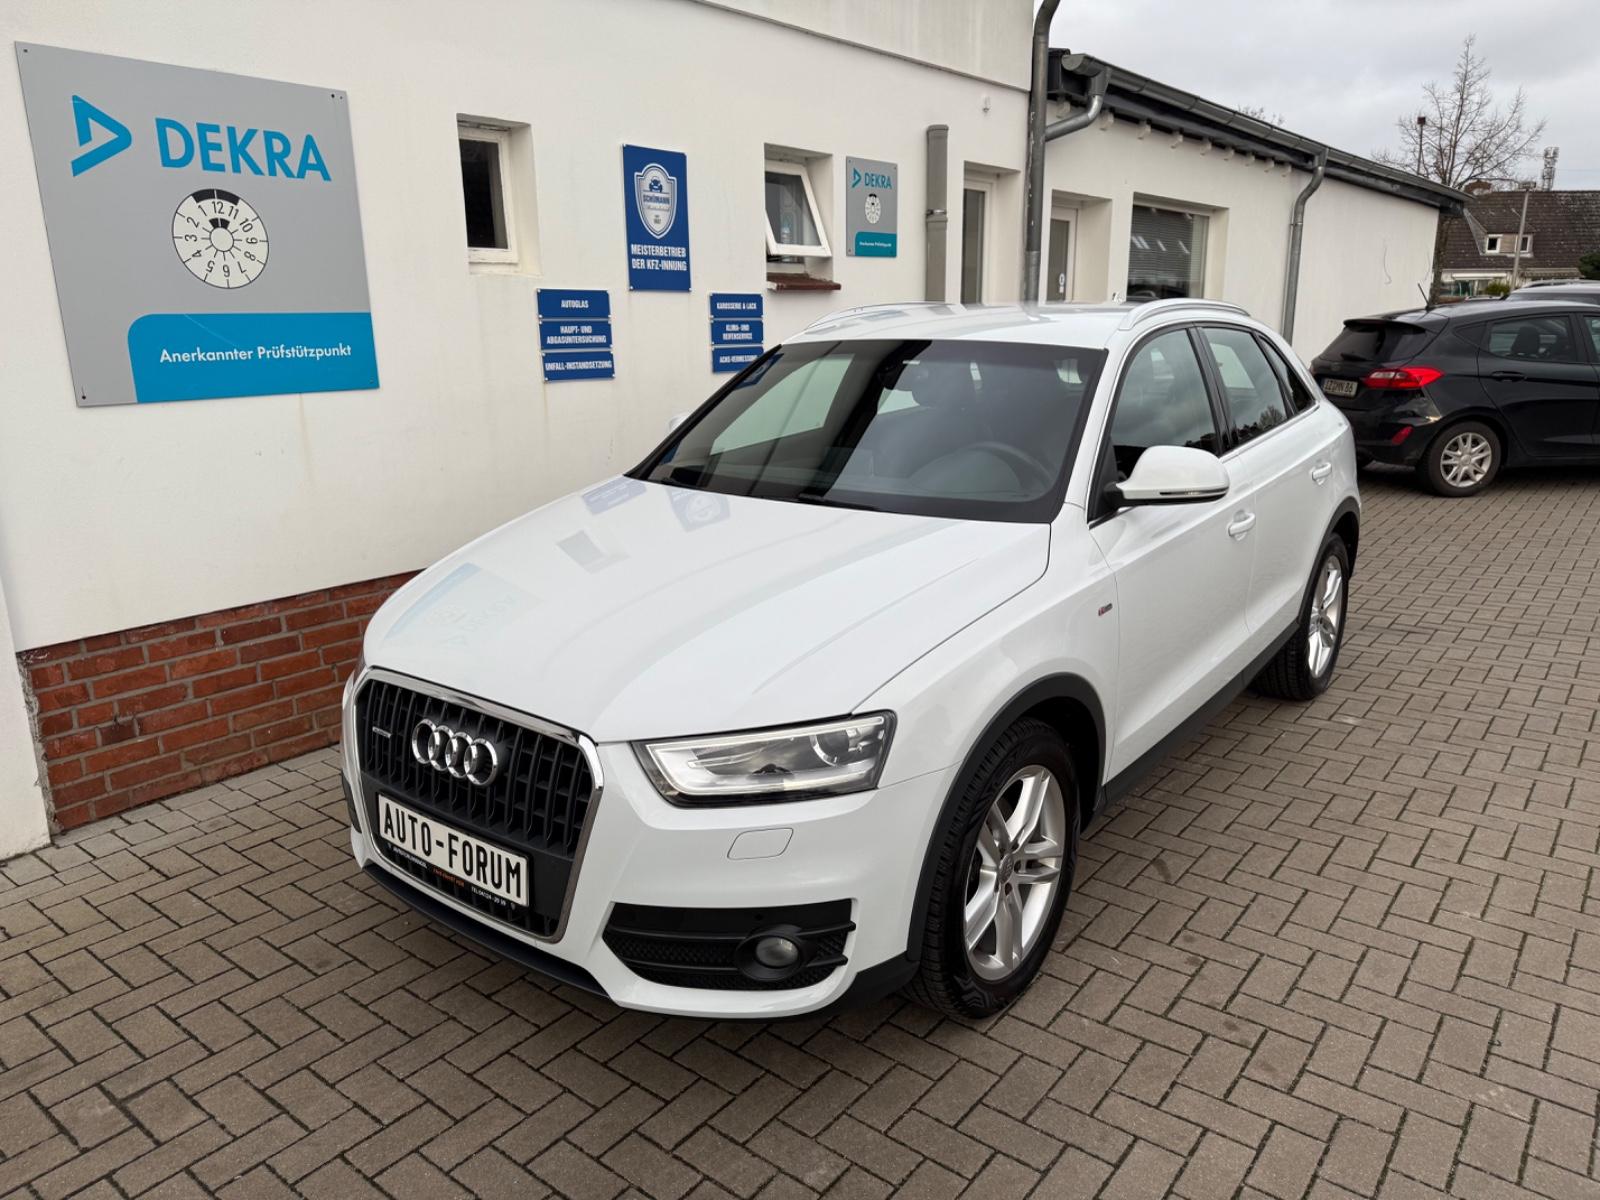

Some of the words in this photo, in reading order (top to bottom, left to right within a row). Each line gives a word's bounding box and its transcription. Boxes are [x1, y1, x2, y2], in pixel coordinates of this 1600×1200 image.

[155, 117, 332, 181] DEKRA
[864, 173, 892, 189] DEKRA
[211, 200, 226, 215] 12
[227, 205, 240, 220] 11
[186, 216, 201, 229] 2
[239, 218, 253, 233] 10
[184, 234, 198, 243] 3
[245, 236, 258, 245] 9
[191, 249, 202, 258] 4
[243, 250, 256, 261] 8
[631, 243, 687, 257] MEISTERBETRIEB
[205, 260, 216, 273] 5
[222, 264, 231, 278] 6
[237, 261, 247, 274] 7
[631, 258, 645, 270] DER
[646, 259, 688, 271] KFZ-INNUNG
[560, 299, 589, 309] AUTOGLAS
[159, 347, 254, 363] Anerkannter
[256, 342, 352, 361] Prüfstützpunkt
[384, 802, 521, 898] AUTO-FORUM
